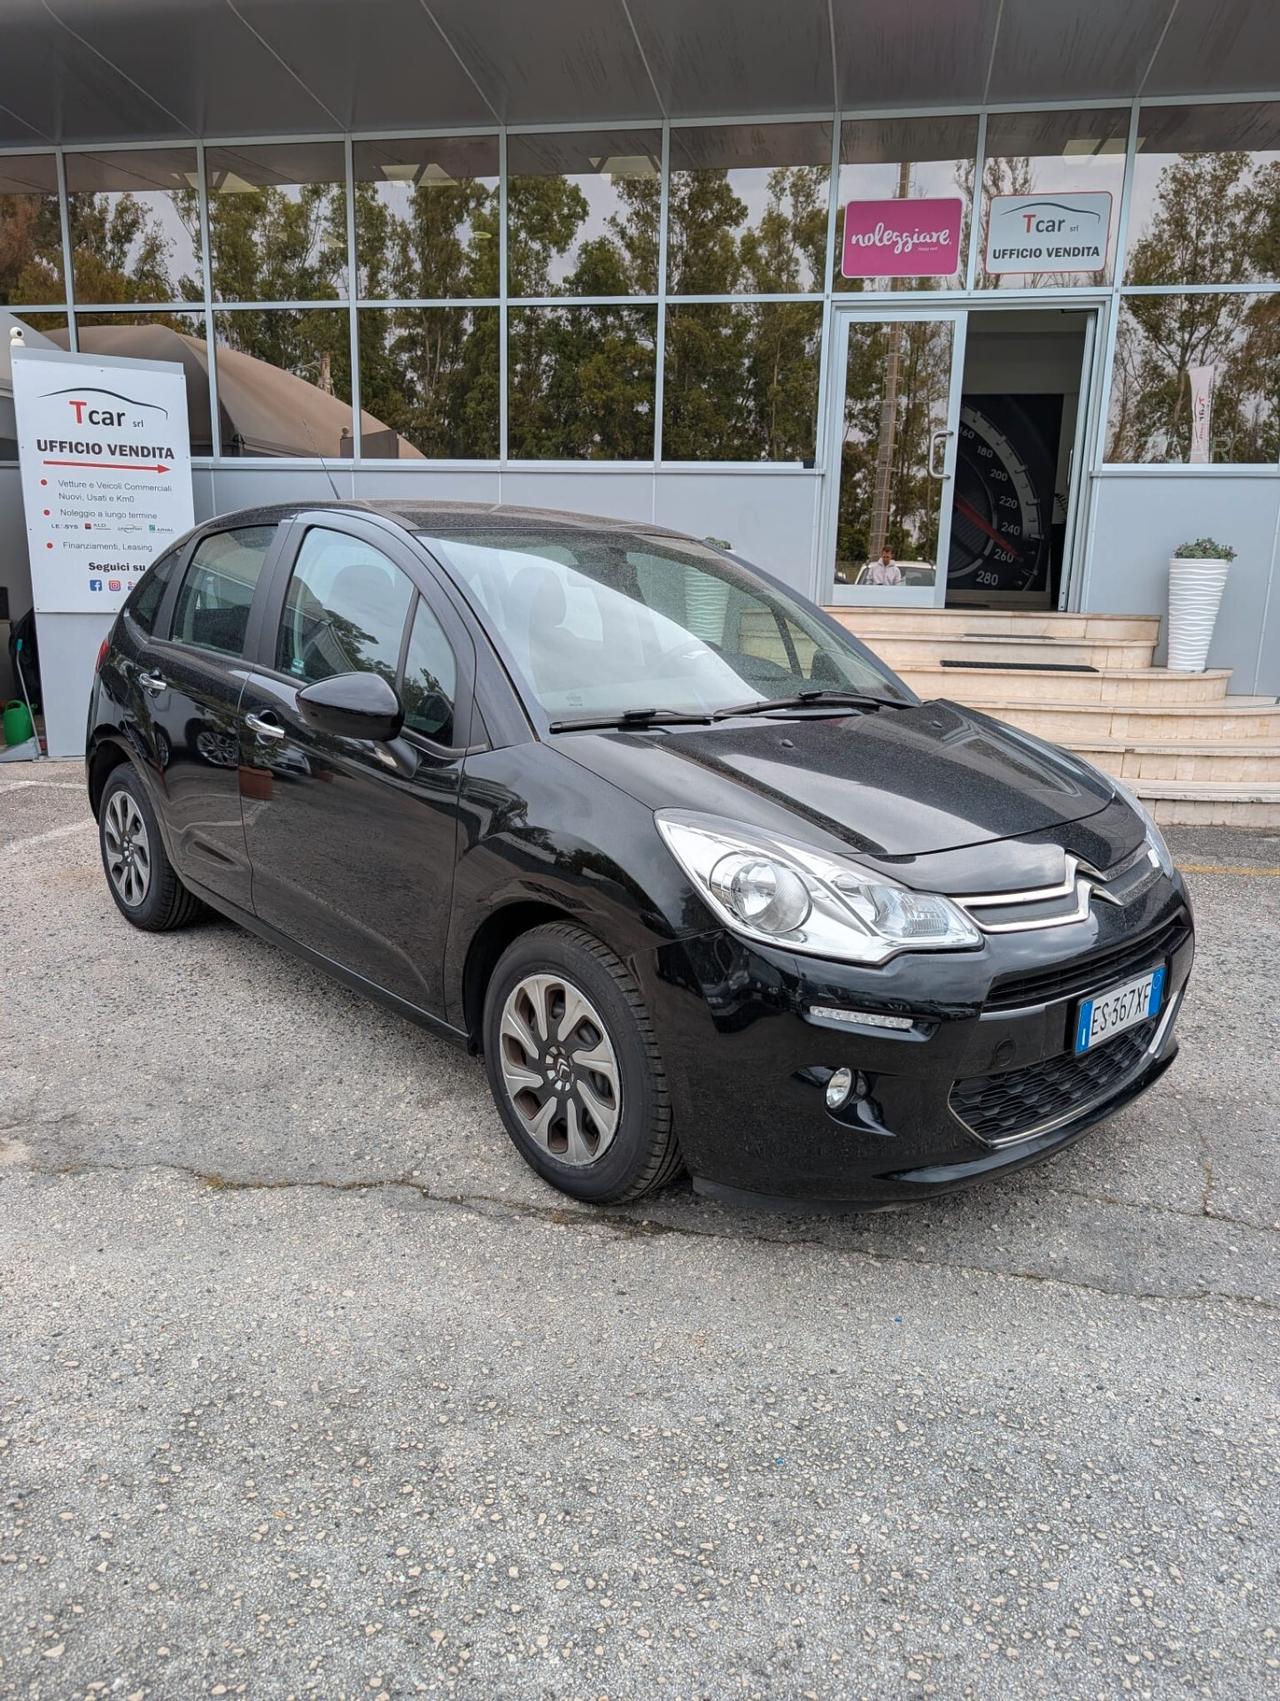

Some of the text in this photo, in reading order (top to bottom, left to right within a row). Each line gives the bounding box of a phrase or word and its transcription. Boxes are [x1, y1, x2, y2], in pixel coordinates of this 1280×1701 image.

[1023, 214, 1065, 233] Tcar
[993, 246, 1100, 259] UFFICIO VENDITA
[69, 400, 144, 428] Tcar srl
[36, 439, 175, 459] UFFICIO VENDITA
[977, 445, 993, 458] 180
[990, 469, 1008, 482] 200
[58, 480, 87, 489] Vetture
[96, 481, 122, 490] Veicoli
[124, 483, 172, 492] Commerciali
[116, 495, 135, 503] Km0
[999, 496, 1018, 509] 220
[60, 509, 96, 519] Noleggio
[105, 510, 127, 519] lungo
[129, 511, 158, 520] termine
[1001, 522, 1020, 536] 240
[63, 542, 153, 552] Finanziamenti, Leasing
[994, 549, 1014, 563] 260
[88, 562, 130, 573] Seguici
[976, 571, 999, 586] 280
